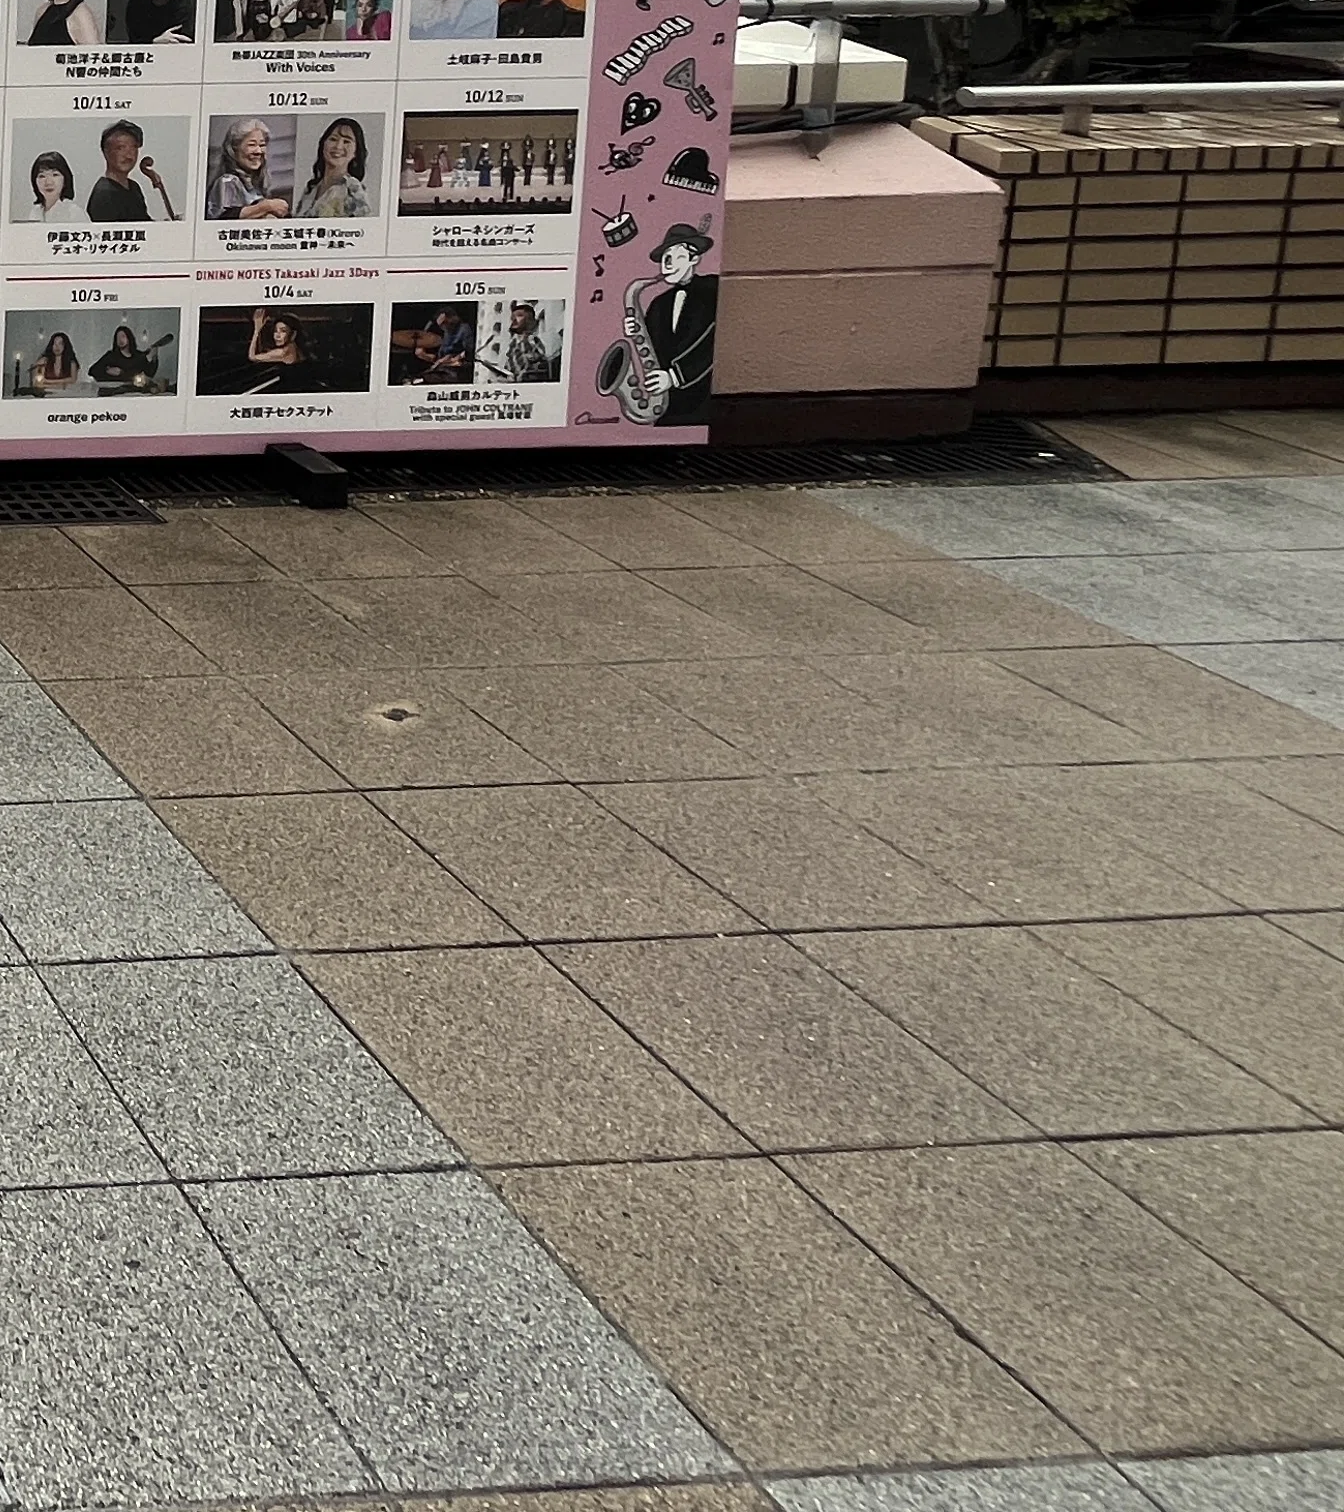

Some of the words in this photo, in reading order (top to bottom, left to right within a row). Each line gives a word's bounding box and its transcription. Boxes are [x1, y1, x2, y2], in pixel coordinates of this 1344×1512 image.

[266, 62, 293, 74] With
[296, 61, 335, 74] Voices
[73, 96, 111, 110] 10/11
[269, 93, 311, 106] 10/12
[466, 90, 503, 103] 10/12
[432, 224, 536, 236] シャローネシンガーズ
[264, 285, 294, 298] 10/4
[455, 282, 488, 295] 10/5
[71, 289, 101, 302] 10/3
[48, 414, 88, 424] orange
